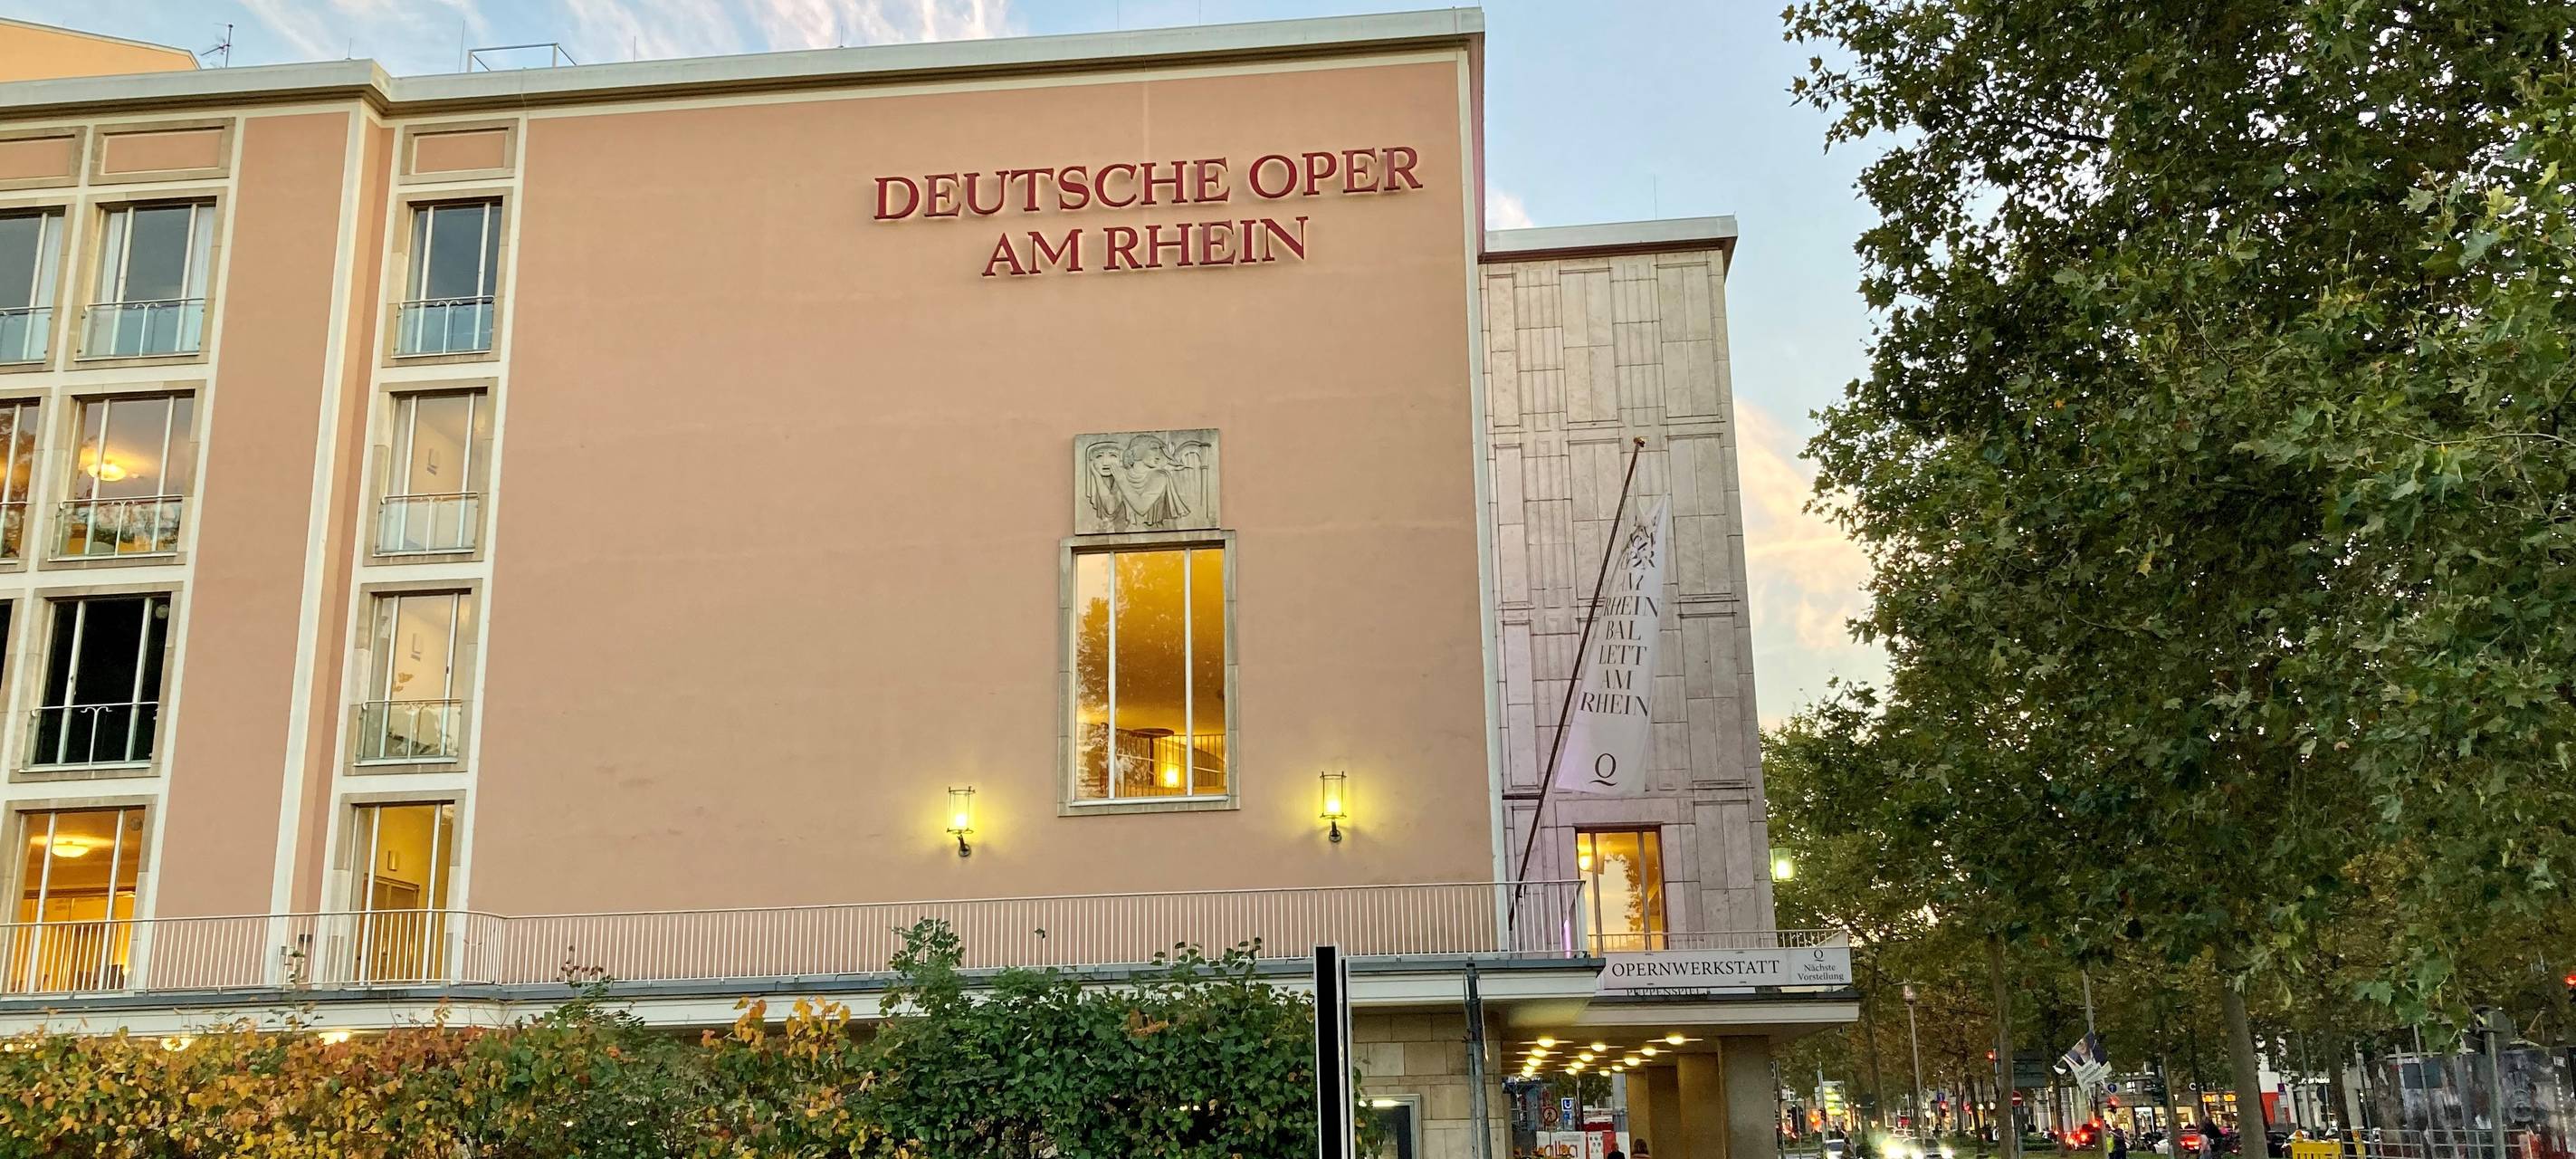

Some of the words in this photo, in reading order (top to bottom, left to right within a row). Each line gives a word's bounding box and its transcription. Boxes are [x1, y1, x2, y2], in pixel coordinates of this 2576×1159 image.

[873, 156, 1230, 220] DEUTSCHE
[1248, 145, 1424, 199] OPER
[981, 228, 1083, 277] AM
[1102, 216, 1309, 272] RHEIN
[1603, 596, 1659, 618] RHEIN
[1606, 620, 1641, 641] BAL
[1598, 645, 1647, 666] LETT
[1601, 669, 1631, 690] AM
[1580, 693, 1648, 717] RHEIN
[1589, 752, 1618, 786] Q
[1813, 949, 1825, 963] Q
[1612, 961, 1779, 977] OPERNWERKSTATT
[1798, 972, 1844, 982] Vorstellung
[1804, 963, 1836, 972] Nächste
